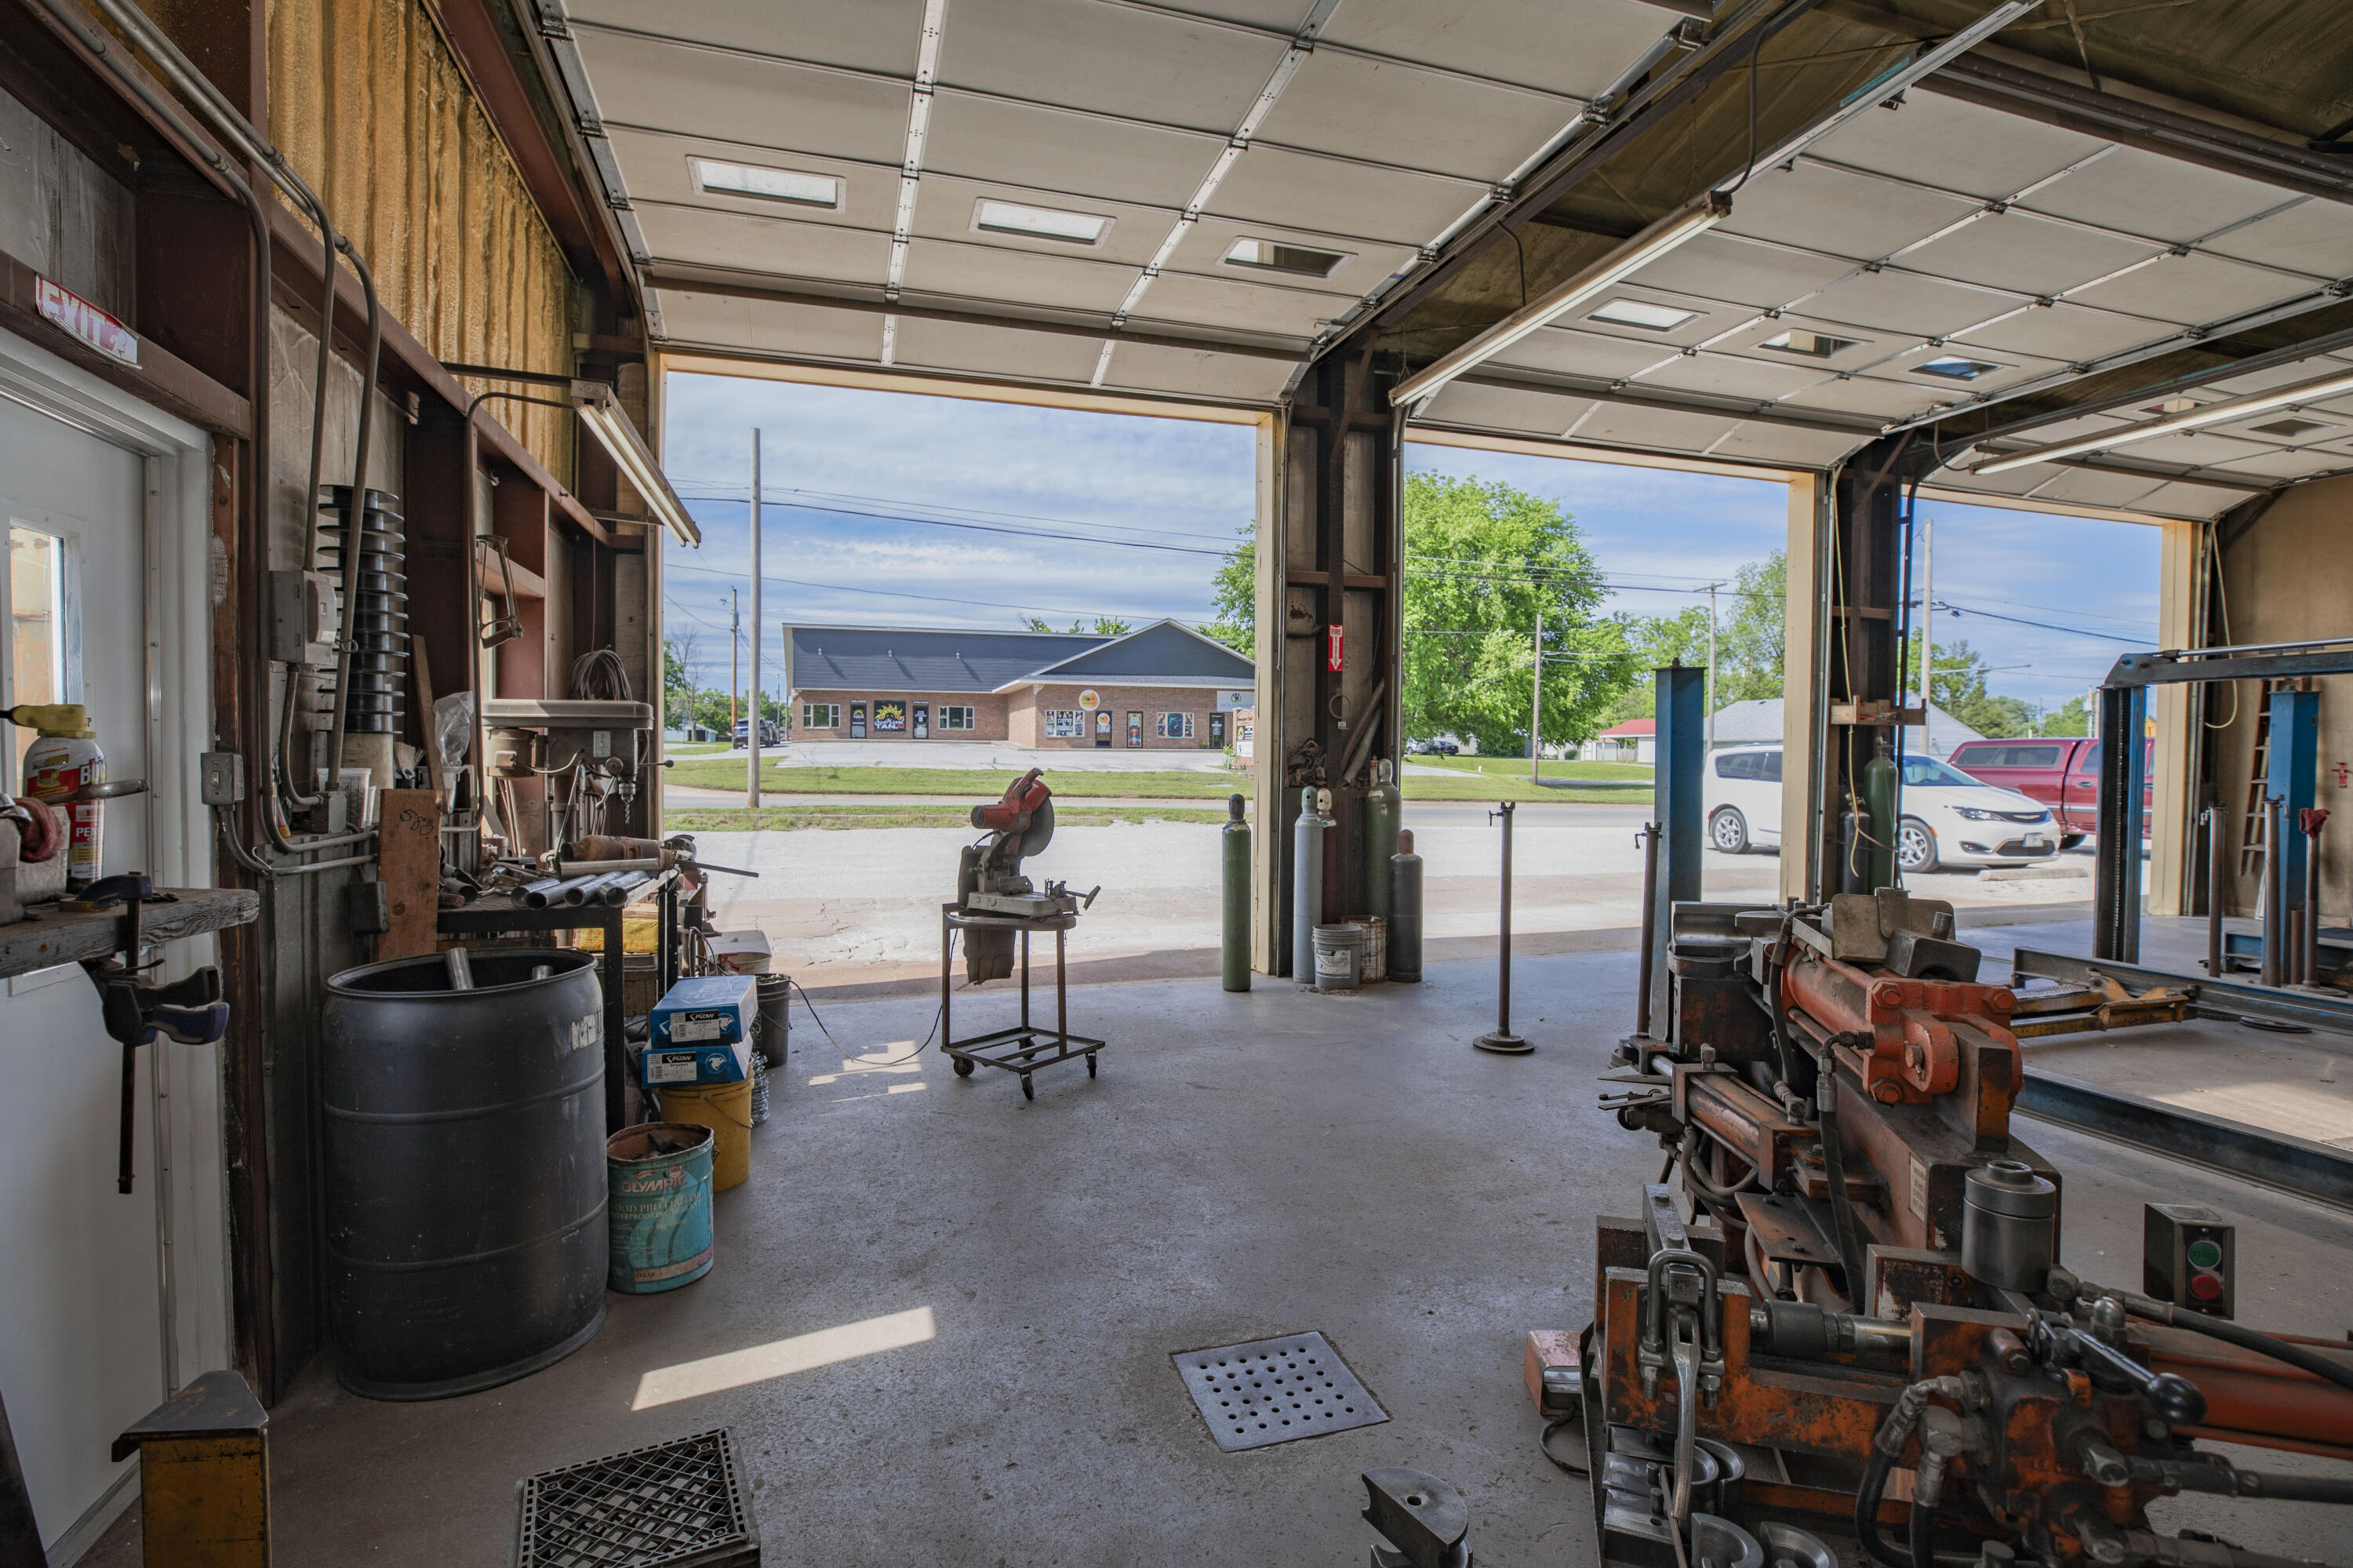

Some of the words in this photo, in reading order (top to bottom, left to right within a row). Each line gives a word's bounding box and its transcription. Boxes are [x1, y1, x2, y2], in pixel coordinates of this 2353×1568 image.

[42, 278, 106, 347] EXIT
[620, 1173, 688, 1194] OLYMPIC
[609, 1203, 638, 1213] OOD
